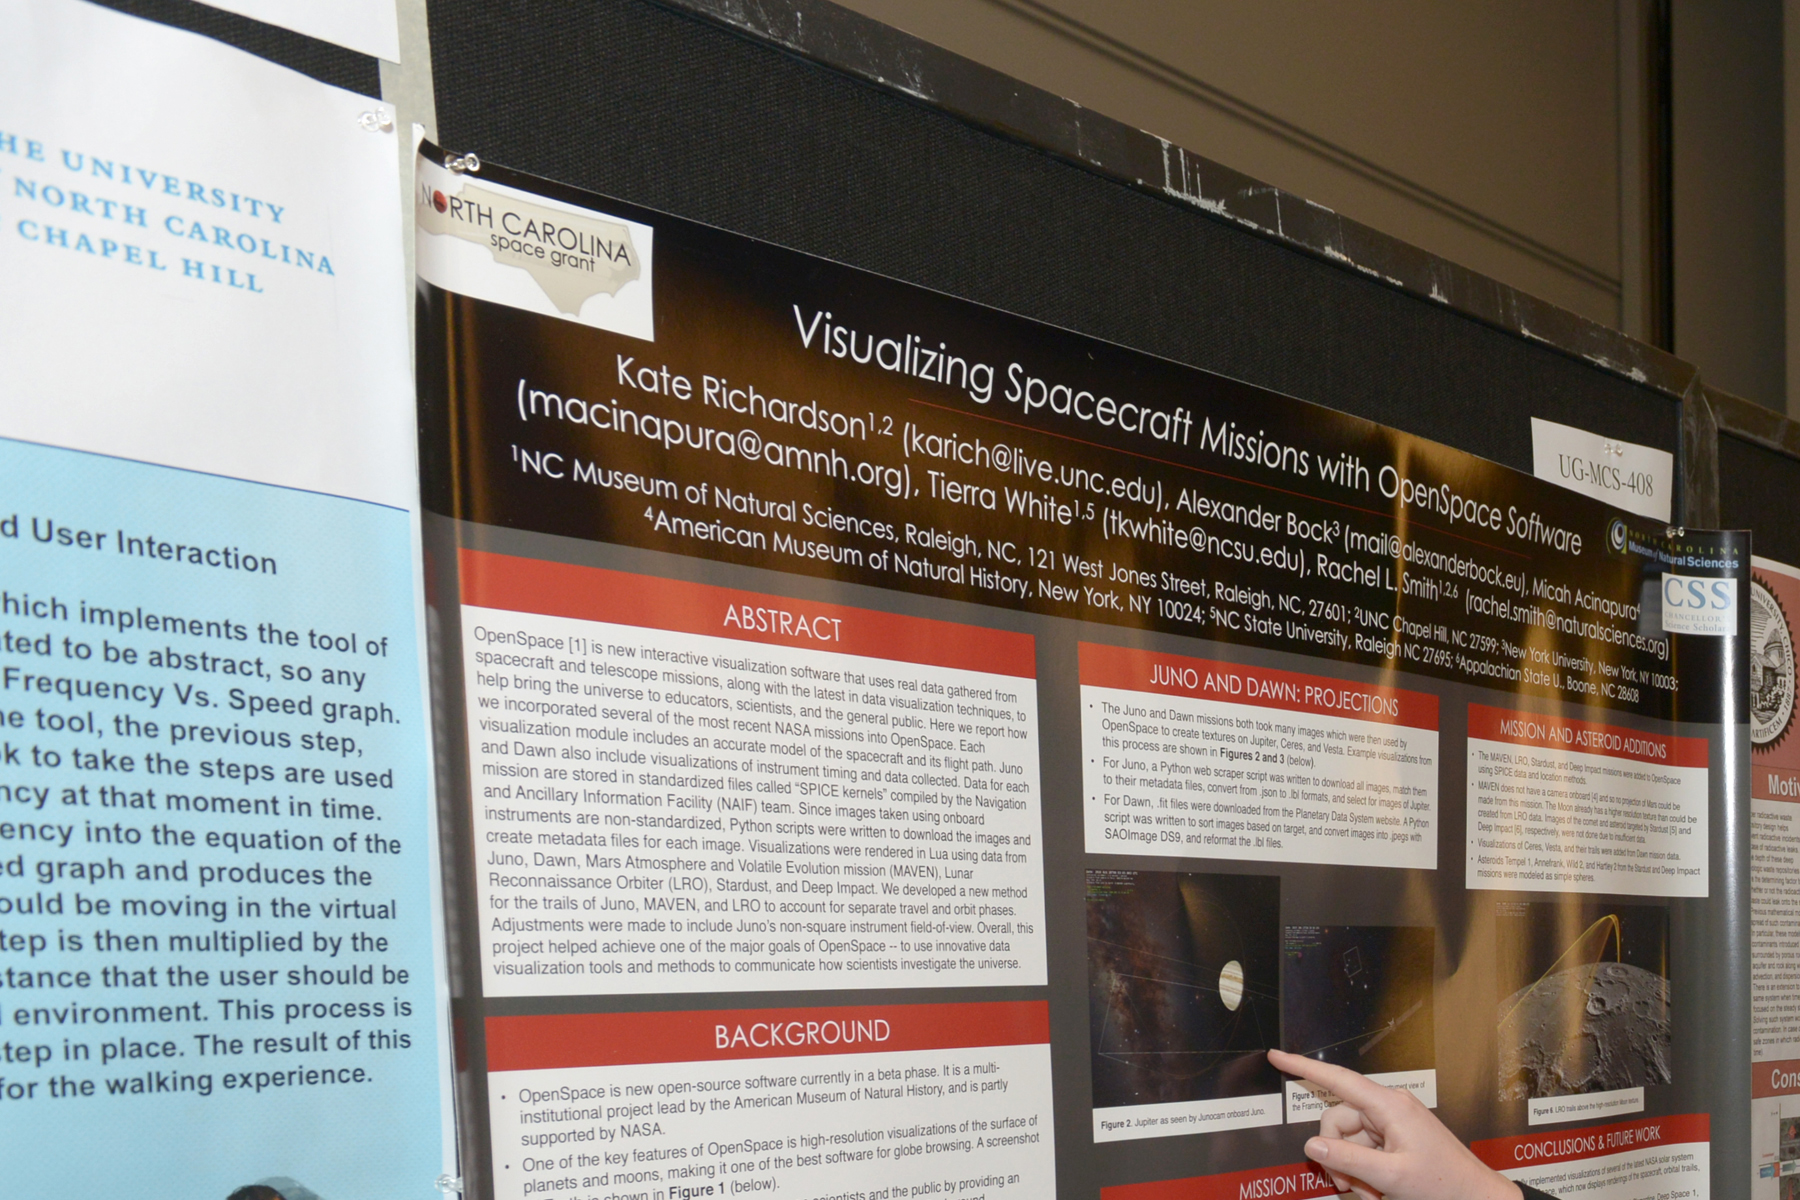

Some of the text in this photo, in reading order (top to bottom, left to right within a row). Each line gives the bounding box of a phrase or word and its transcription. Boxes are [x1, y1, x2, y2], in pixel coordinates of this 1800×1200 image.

[0, 131, 284, 223] HE UNIVERSITY
[14, 177, 335, 276] NORTH CAROLINA
[502, 212, 632, 267] CAROLINA
[17, 219, 263, 293] CHAPEL HILL
[490, 233, 595, 272] space grant
[793, 304, 1582, 556] Visualizing Spacecraft Missions with OpenSpace Software
[518, 379, 919, 500] (macinapura@amnh.org),
[927, 470, 996, 510] Tierra
[1103, 507, 1311, 578] (tkwhite@ncsu.edu),
[1317, 553, 1380, 588] Rachel
[1385, 564, 1401, 591] L.
[617, 354, 692, 400] Kate
[903, 422, 1169, 513] (karich@live.unc.edu),
[1176, 488, 1282, 532] Alexander
[1532, 577, 1572, 605] Micah
[1559, 454, 1654, 497] UG-MCS-408
[32, 517, 107, 550] User
[117, 530, 277, 575] Interaction
[1628, 540, 1653, 559] Museum
[1658, 550, 1686, 566] Natural
[1687, 556, 1739, 569] Sciences
[1664, 577, 1731, 610] CSS
[723, 604, 842, 642] ABSTRACT
[1693, 623, 1728, 633] Scholar
[1149, 664, 1398, 717] JUNO AND DAWN: PROJECTIONS
[1500, 720, 1667, 759] MISSION AND ASTEROID ADDITIONS
[13, 996, 412, 1026] environment. This process is
[715, 1019, 890, 1049] BACKGROUND
[521, 1122, 666, 1148] supported by NASA.
[1101, 1120, 1125, 1132] Figure
[1134, 1118, 1159, 1128] Jupiter
[1159, 1117, 1169, 1125] as
[1170, 1116, 1188, 1124] seen
[1188, 1114, 1198, 1124] by
[1198, 1112, 1226, 1122] Junocam
[1226, 1108, 1250, 1119] onboard
[1250, 1108, 1266, 1116] Juno.
[1514, 1125, 1661, 1161] CONCLUSIONS & FUTURE WORK
[1239, 1174, 1296, 1200] MISSION
